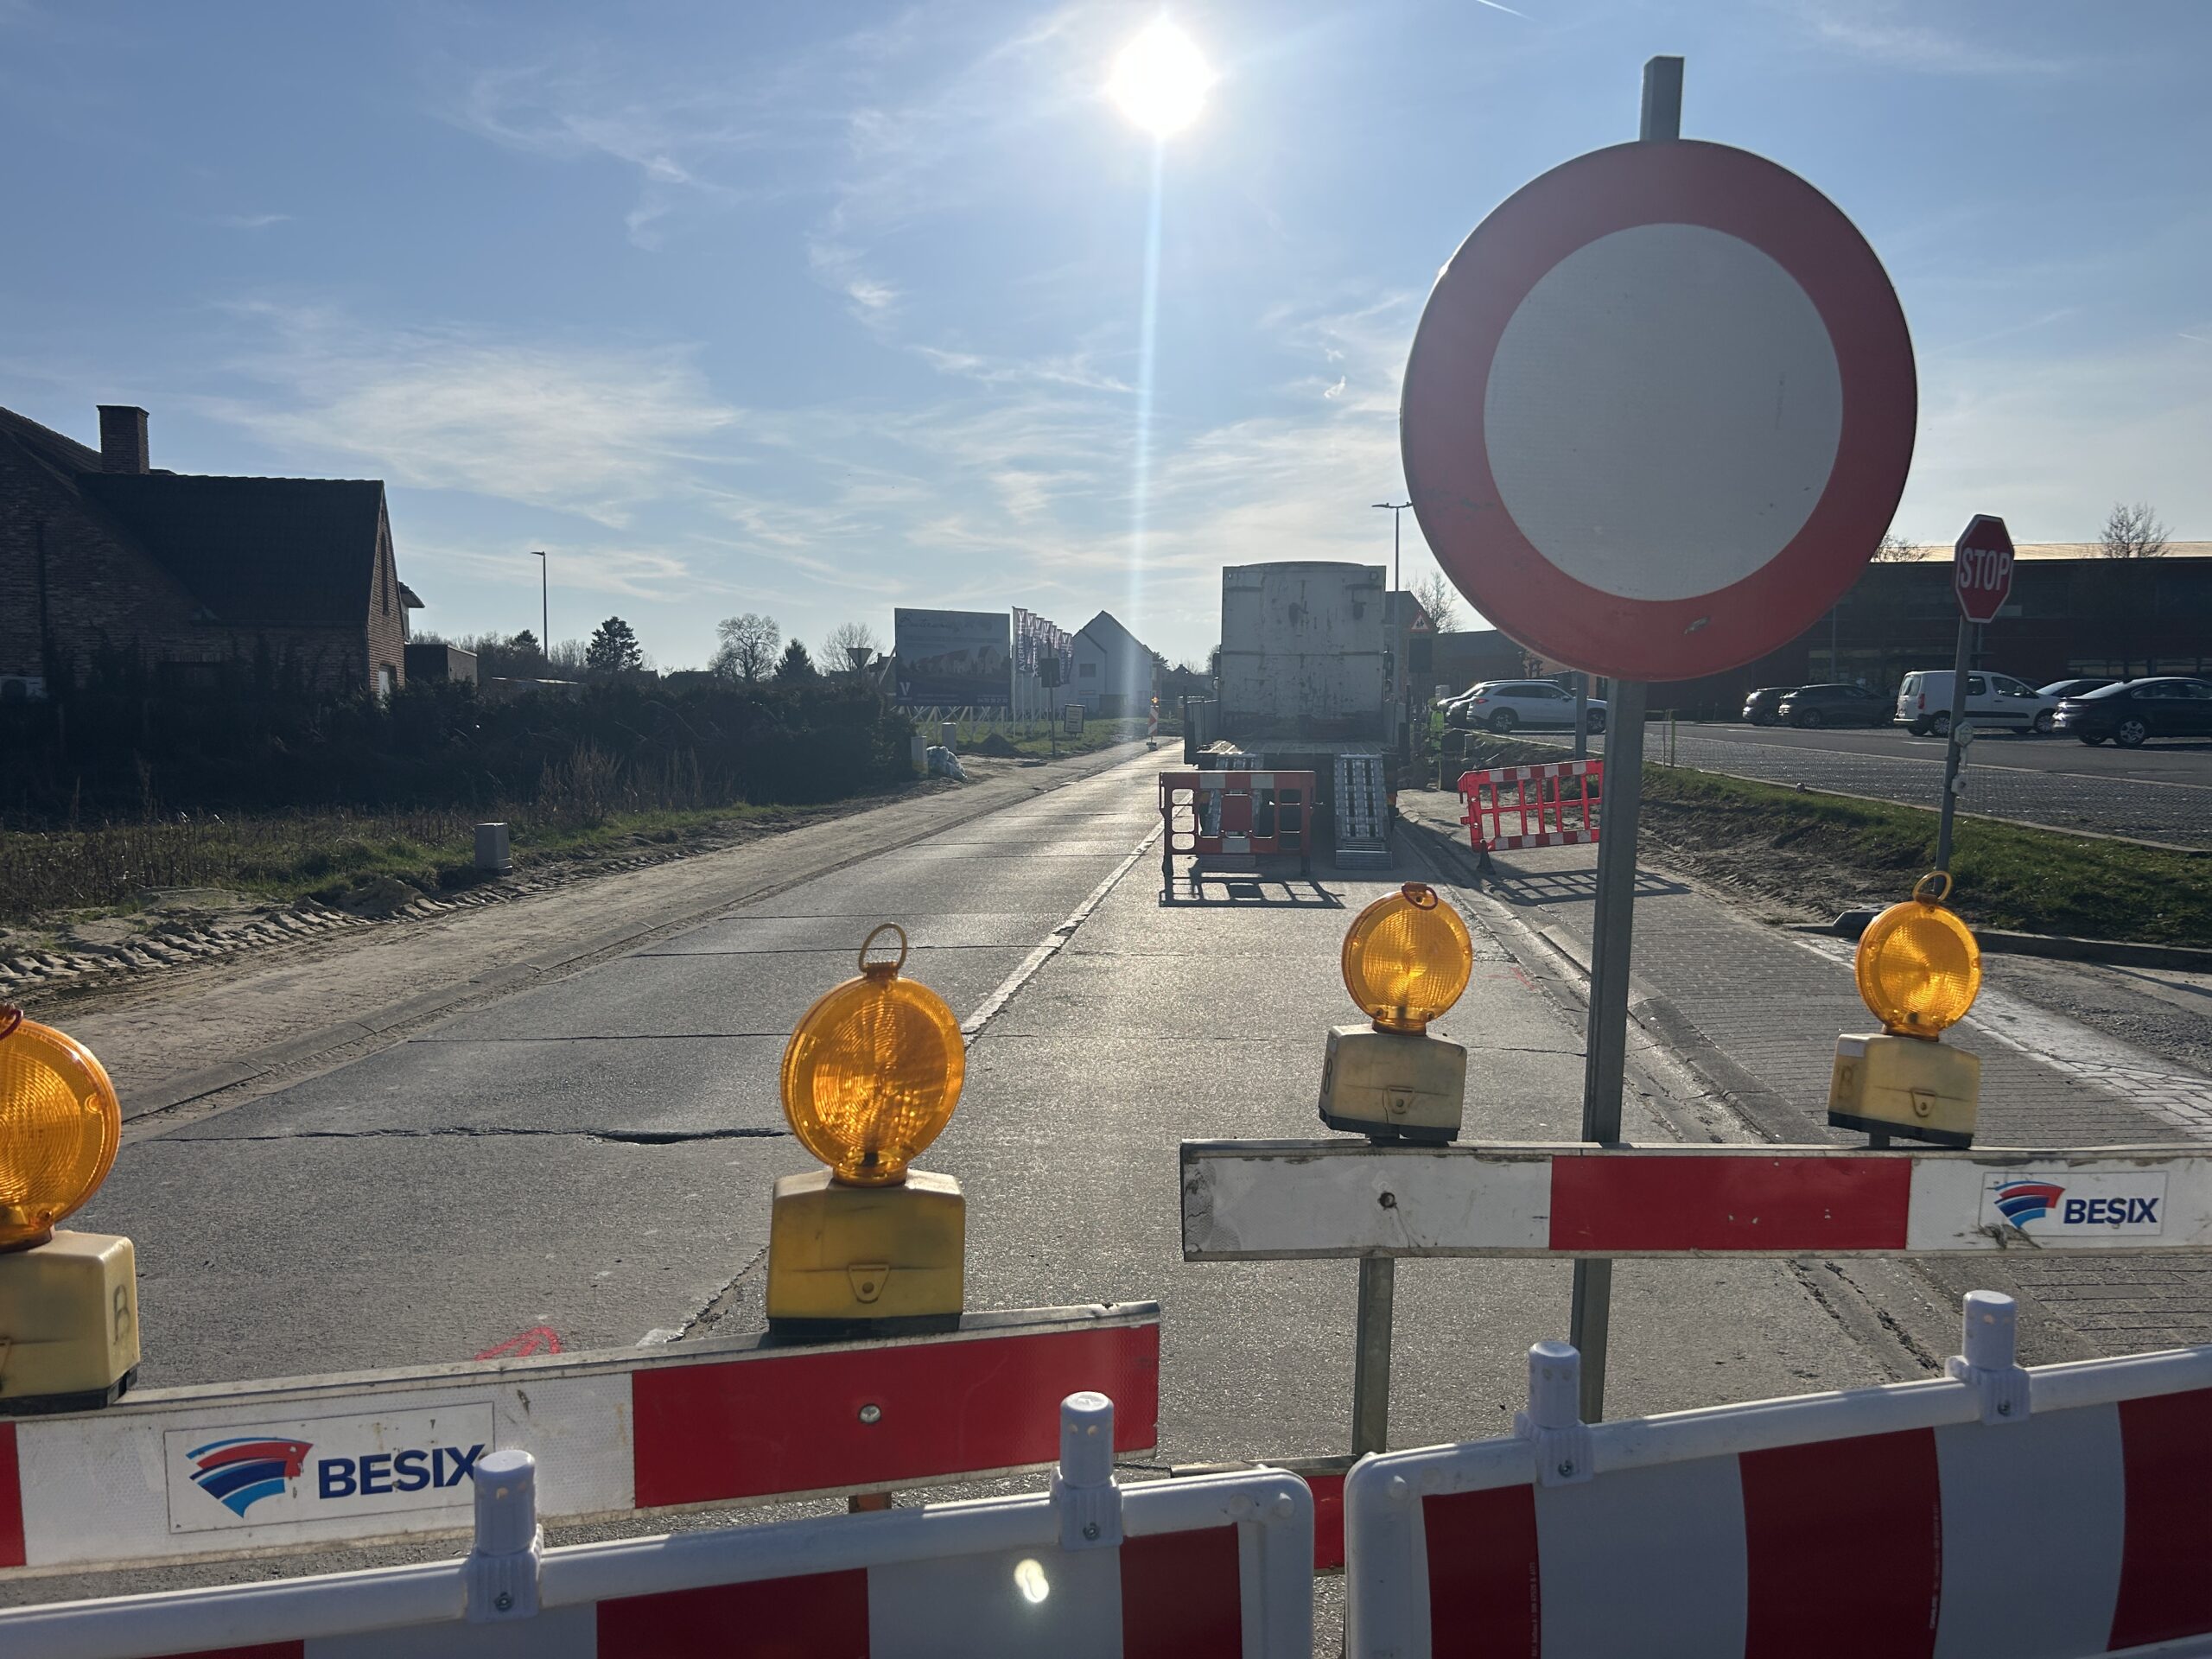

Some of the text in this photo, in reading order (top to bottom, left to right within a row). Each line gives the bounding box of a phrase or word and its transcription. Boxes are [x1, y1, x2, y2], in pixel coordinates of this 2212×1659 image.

[1960, 547, 2011, 591] STOP
[2063, 1198, 2159, 1225] BESIX
[318, 1444, 486, 1500] BESIX
